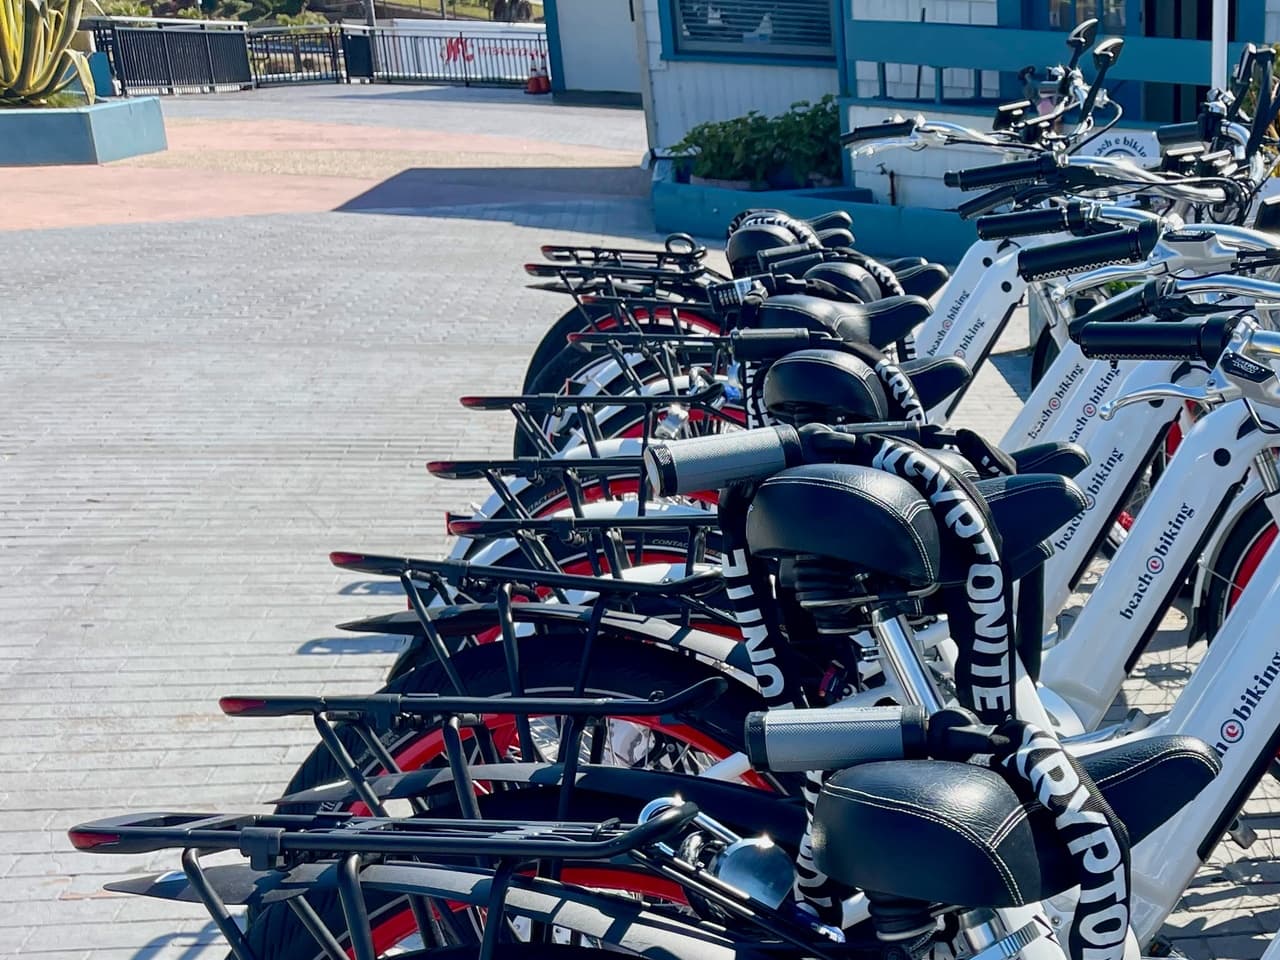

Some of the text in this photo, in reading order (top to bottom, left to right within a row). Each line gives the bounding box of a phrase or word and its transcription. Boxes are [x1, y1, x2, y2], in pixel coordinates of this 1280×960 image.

[1122, 136, 1147, 158] bikin
[927, 329, 947, 357] beach
[946, 291, 970, 321] biking
[959, 318, 985, 351] biking
[1027, 409, 1053, 440] beach
[1055, 363, 1084, 400] biking
[1068, 416, 1089, 443] each
[1089, 367, 1121, 405] biking
[1087, 447, 1125, 496] biking
[651, 538, 689, 549] CONTAC
[872, 439, 1012, 712] KRYPTONITE
[1119, 571, 1154, 620] beach
[1154, 502, 1195, 557] biking
